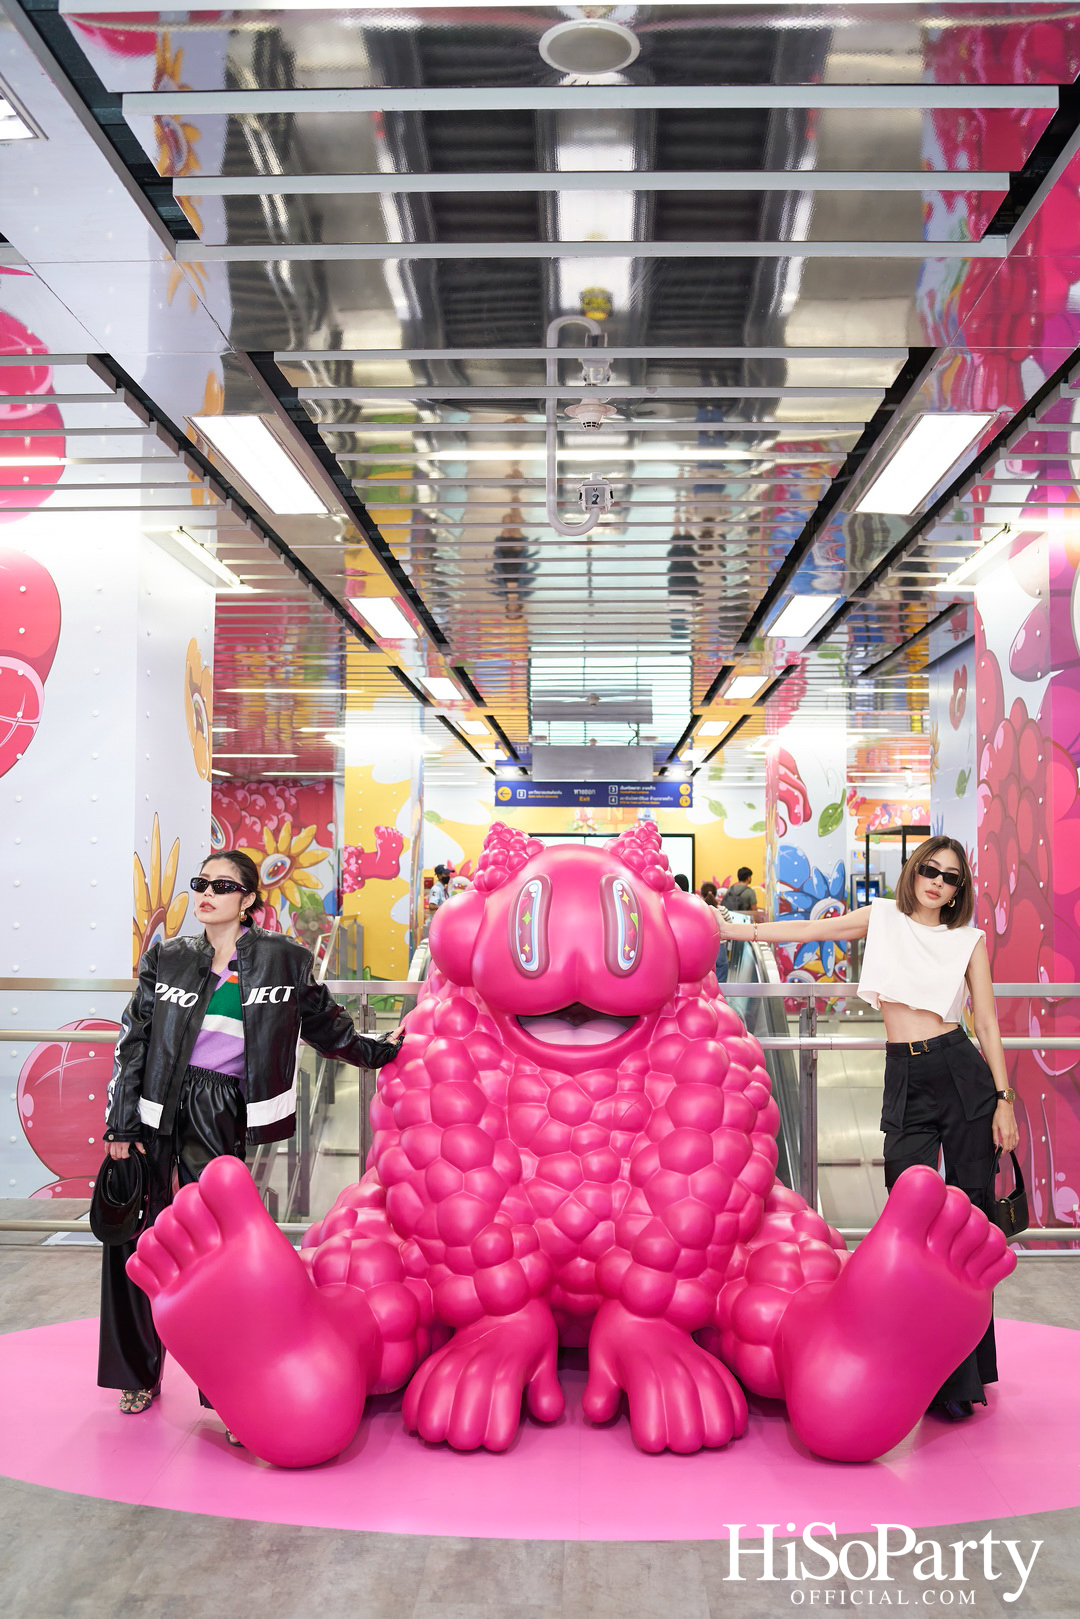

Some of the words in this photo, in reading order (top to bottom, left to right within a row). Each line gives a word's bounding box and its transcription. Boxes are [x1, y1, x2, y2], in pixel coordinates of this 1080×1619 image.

[591, 493, 600, 504] 2
[154, 982, 198, 1007] PRO
[242, 986, 294, 1006] JECT
